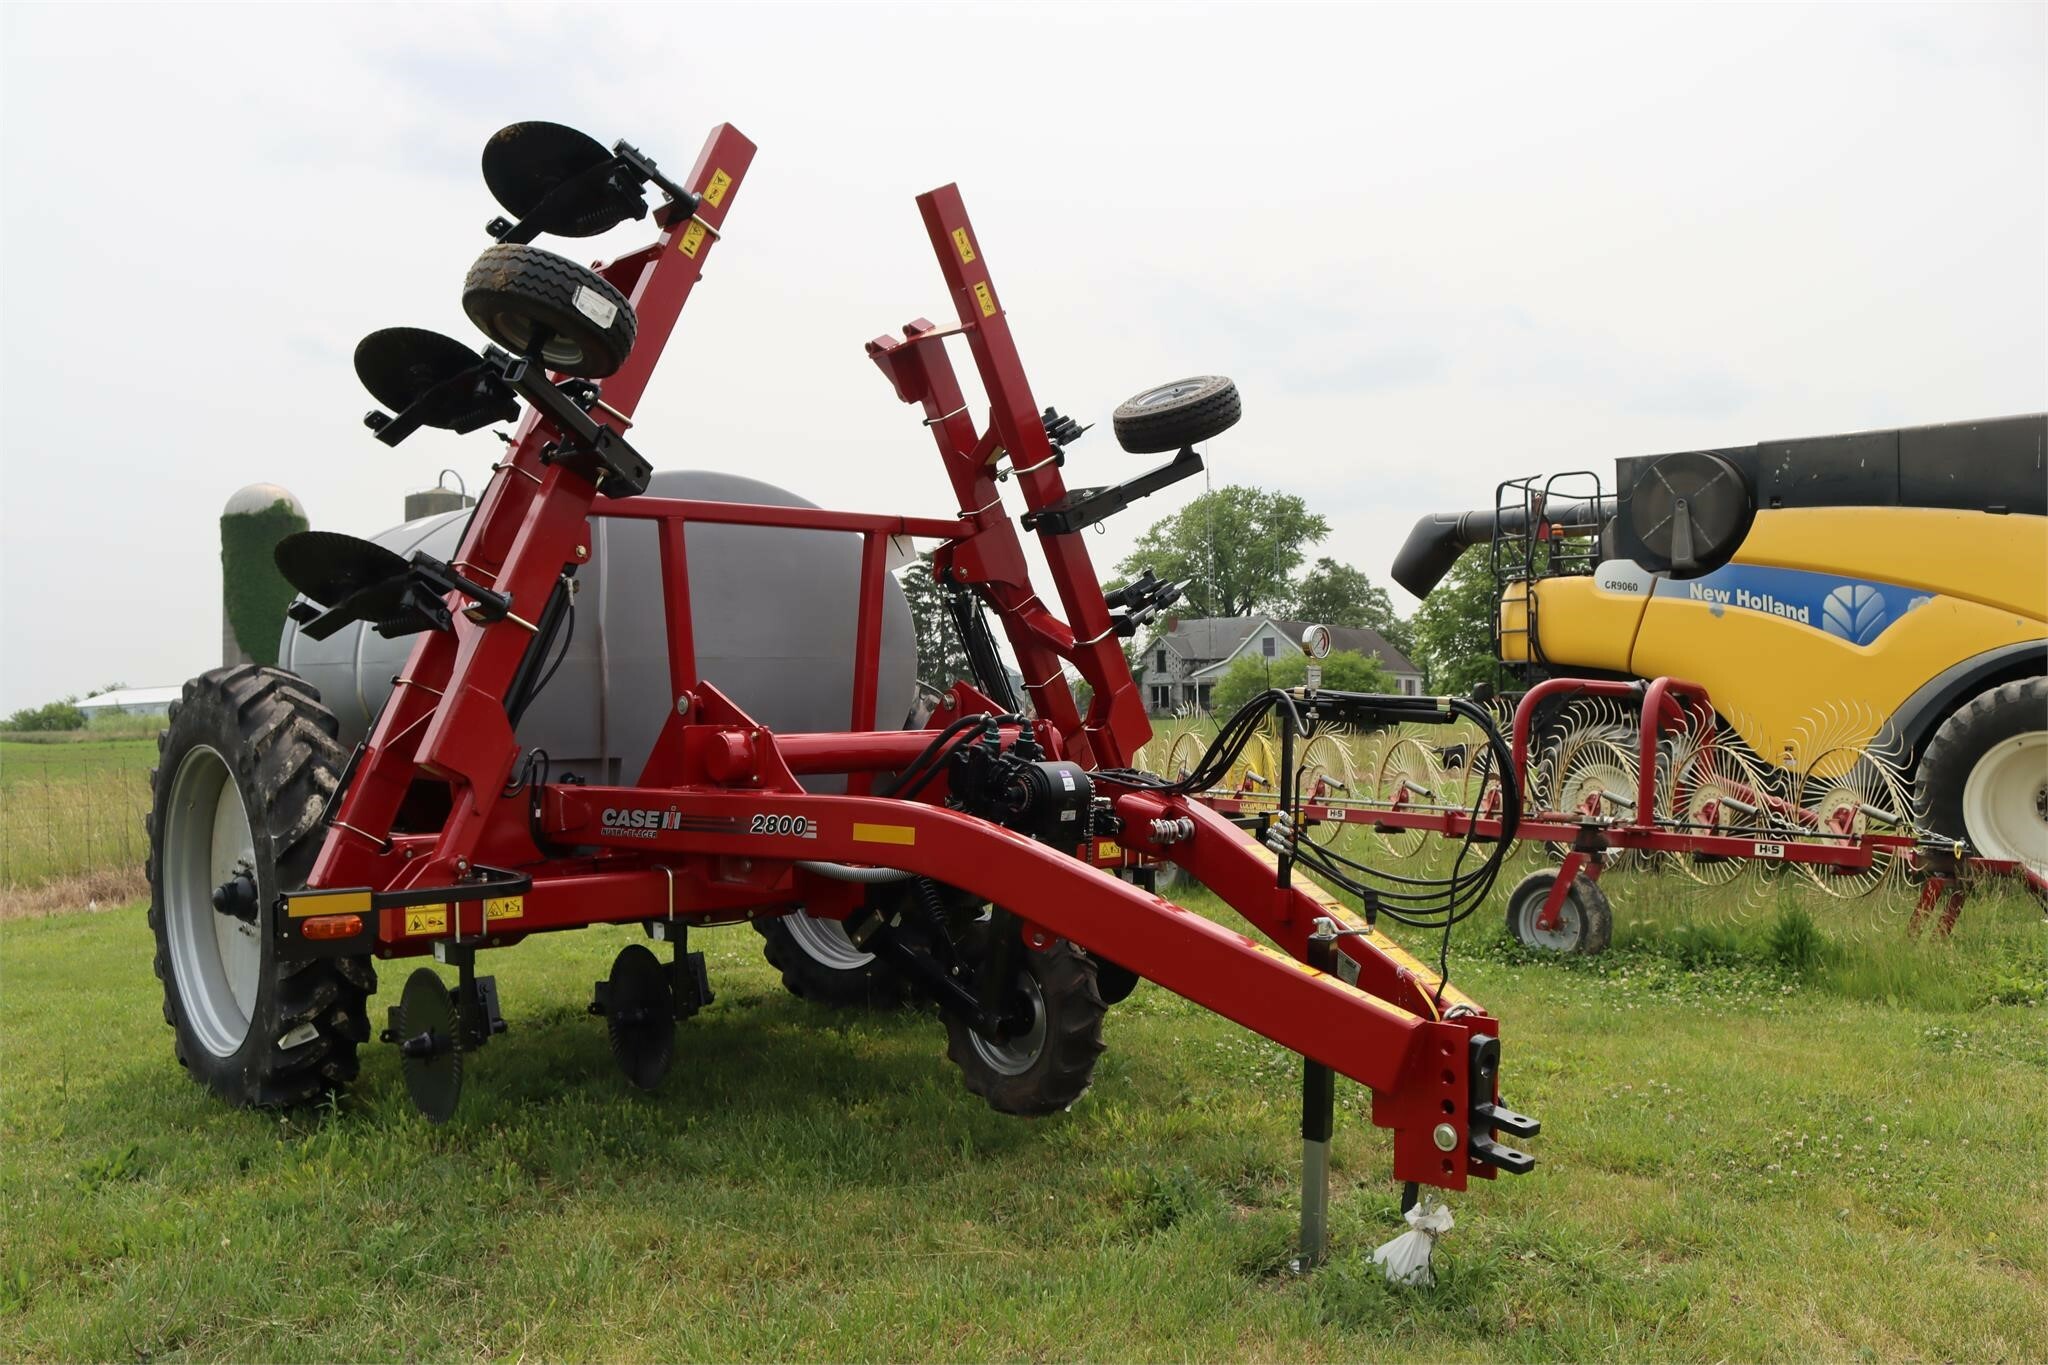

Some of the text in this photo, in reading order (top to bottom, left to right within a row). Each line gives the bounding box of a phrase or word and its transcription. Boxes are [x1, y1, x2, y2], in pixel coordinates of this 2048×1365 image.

[1604, 580, 1639, 592] CR9060
[1689, 581, 1809, 625] New Holland
[601, 808, 660, 828] CASE
[749, 813, 807, 837] 2800
